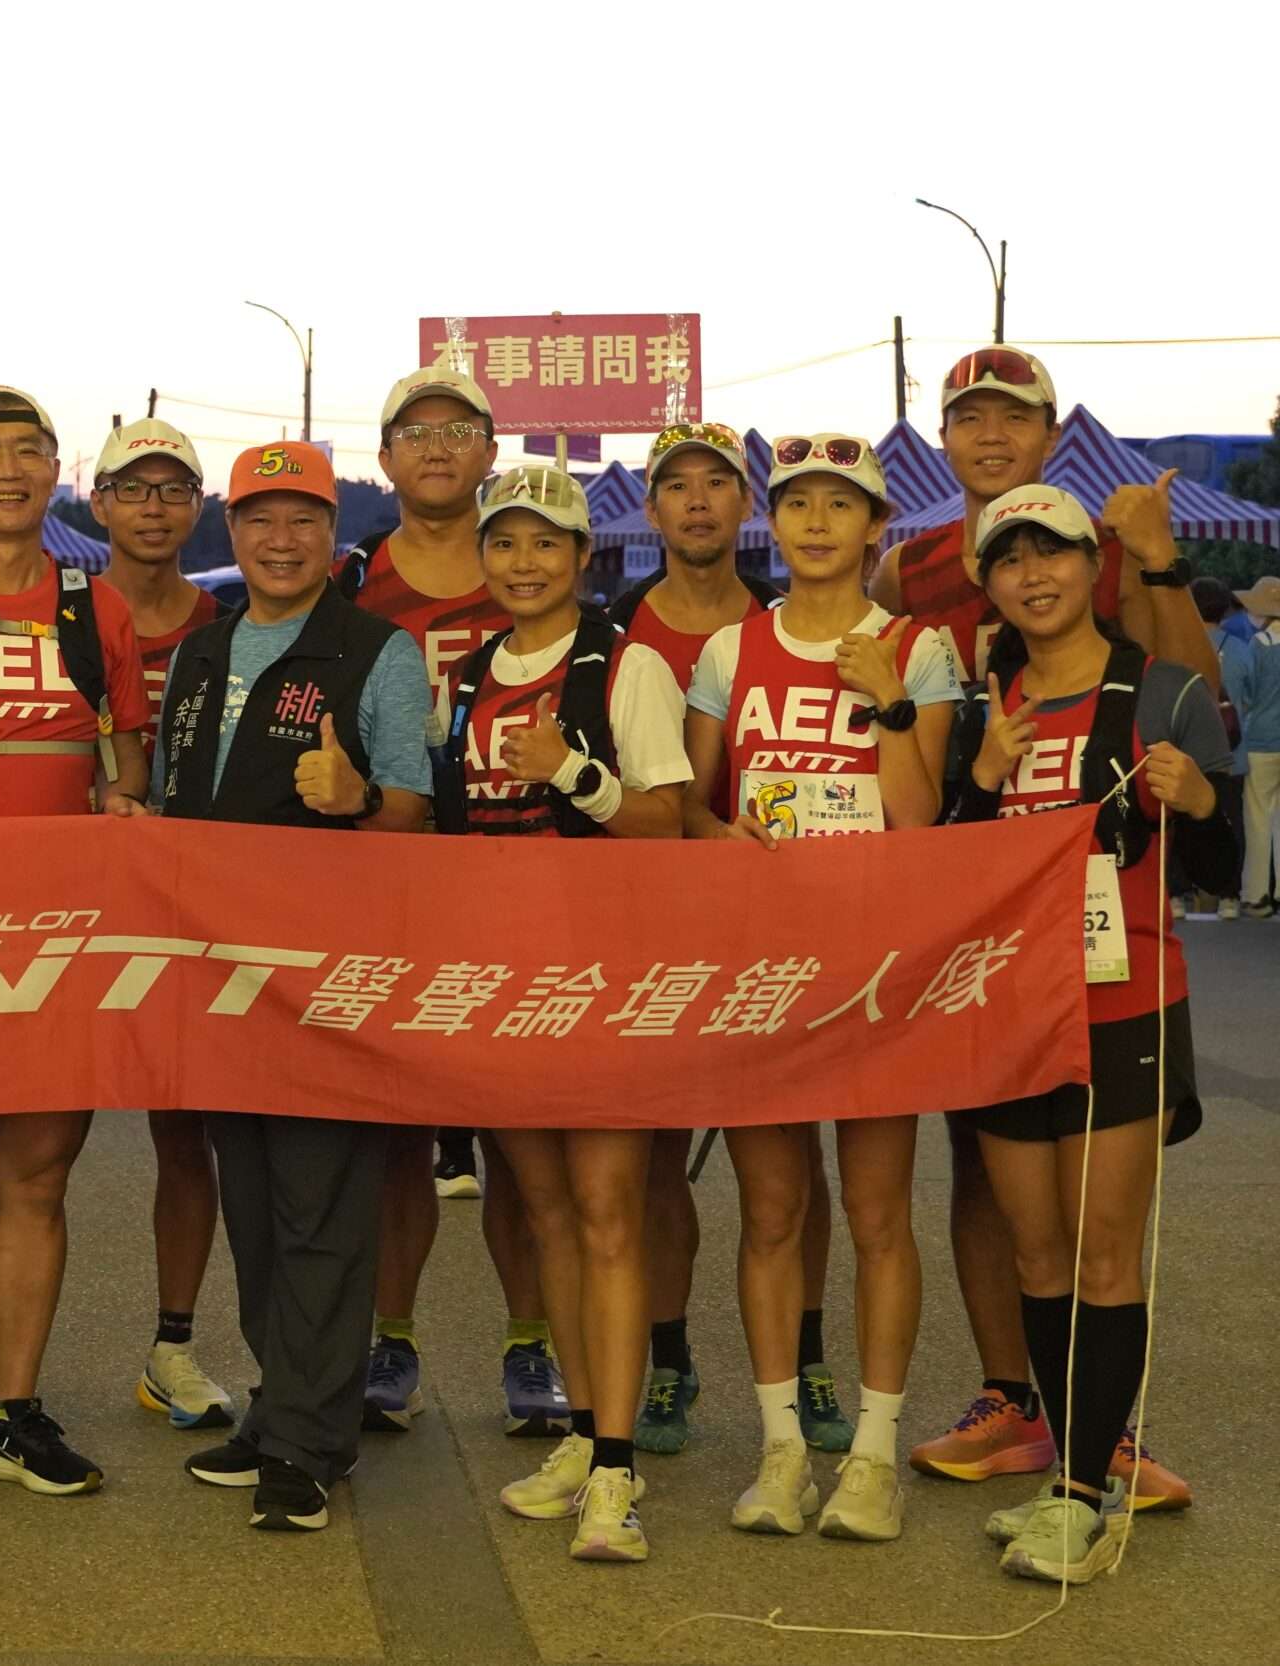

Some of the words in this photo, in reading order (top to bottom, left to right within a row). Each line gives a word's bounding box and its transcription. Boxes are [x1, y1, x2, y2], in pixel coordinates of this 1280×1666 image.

[253, 448, 303, 478] 5th
[179, 678, 208, 748] 大園區長
[747, 750, 859, 773] DVTT
[297, 929, 1025, 1039] 醫聲論壇鐵人隊
